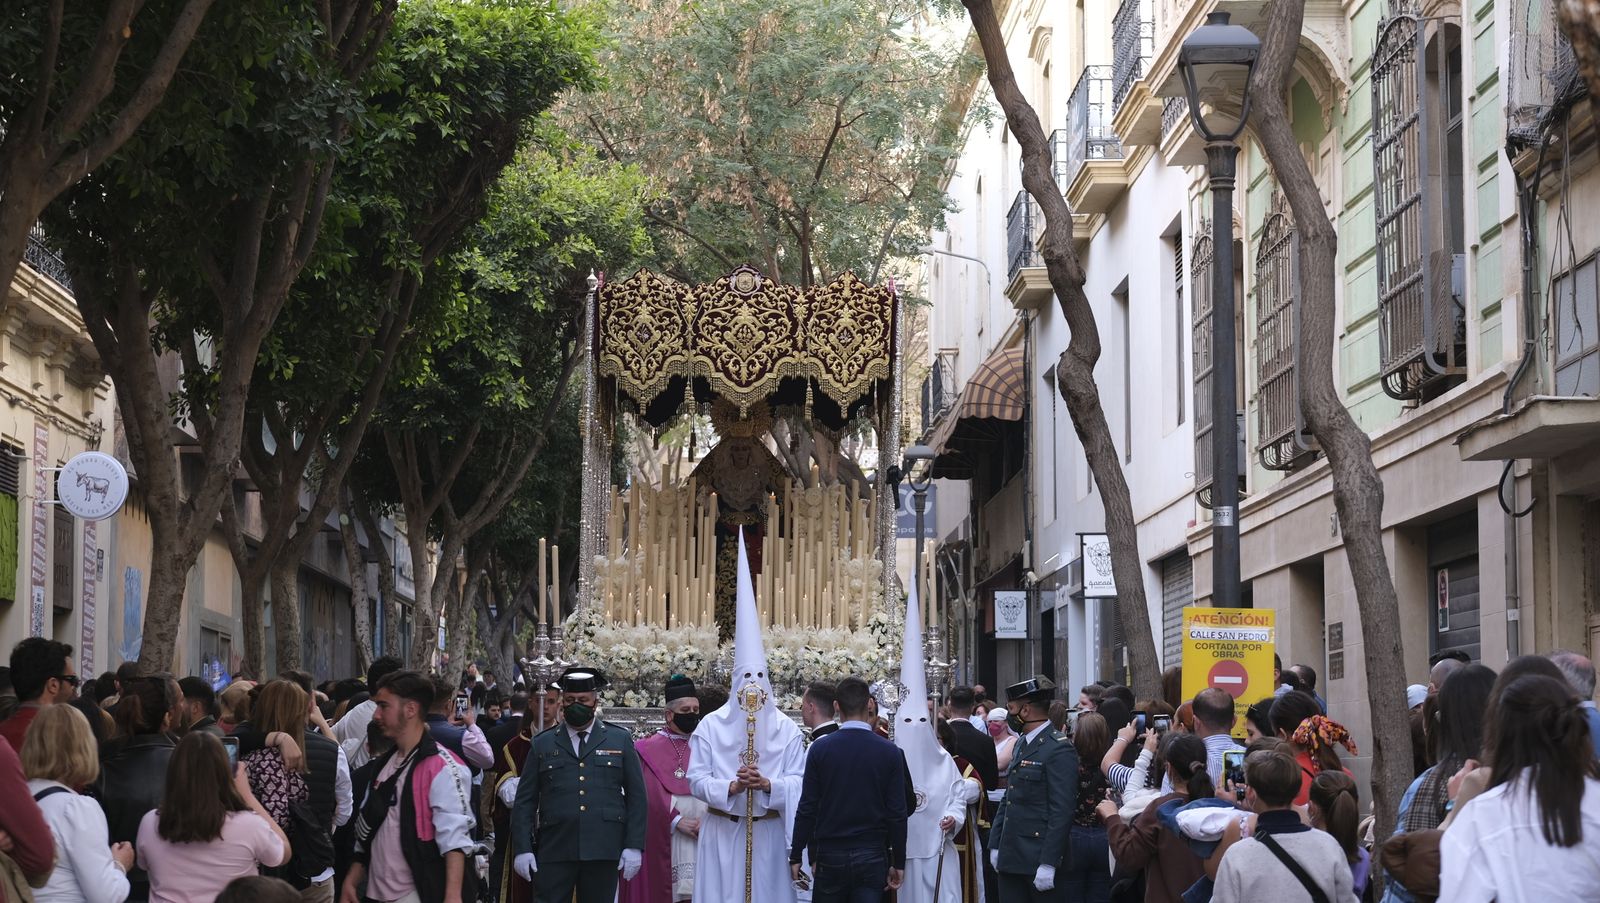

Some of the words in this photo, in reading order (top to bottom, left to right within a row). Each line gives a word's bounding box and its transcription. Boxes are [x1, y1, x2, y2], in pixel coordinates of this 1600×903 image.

[1189, 613, 1269, 626] ¡ATENCIÓN!
[1190, 630, 1216, 639] CALLE
[1217, 631, 1235, 640] SAN
[1238, 632, 1268, 641] PEDRO
[1195, 642, 1239, 651] CORTADA
[1242, 643, 1262, 651] POR
[1212, 650, 1245, 659] OBRAS
